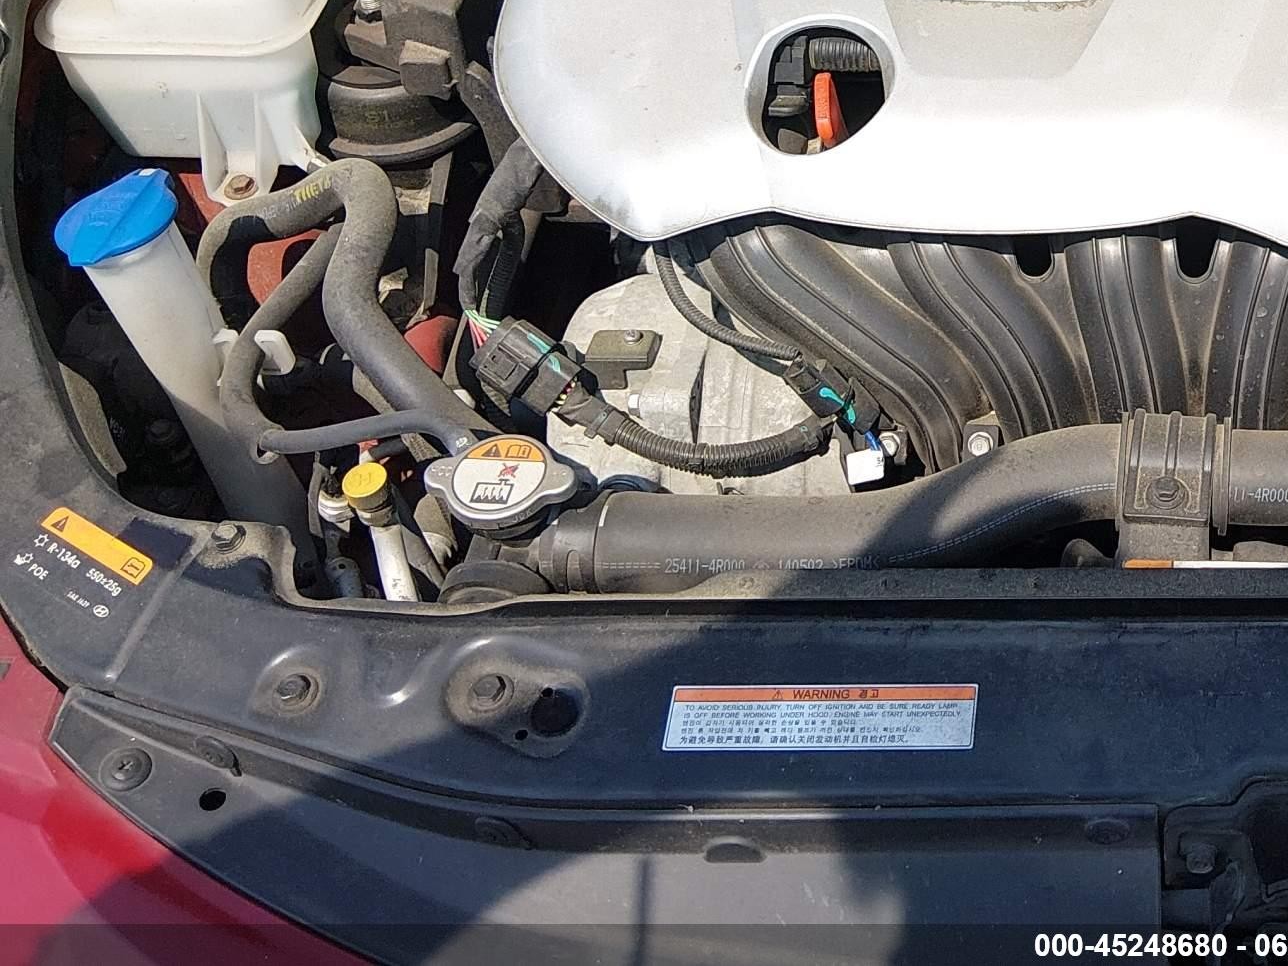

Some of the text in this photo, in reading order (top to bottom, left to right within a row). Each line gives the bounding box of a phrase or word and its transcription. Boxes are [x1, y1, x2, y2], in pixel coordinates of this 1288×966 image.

[47, 542, 81, 569] R-134a
[28, 563, 49, 581] POE
[793, 689, 850, 699] WARNING
